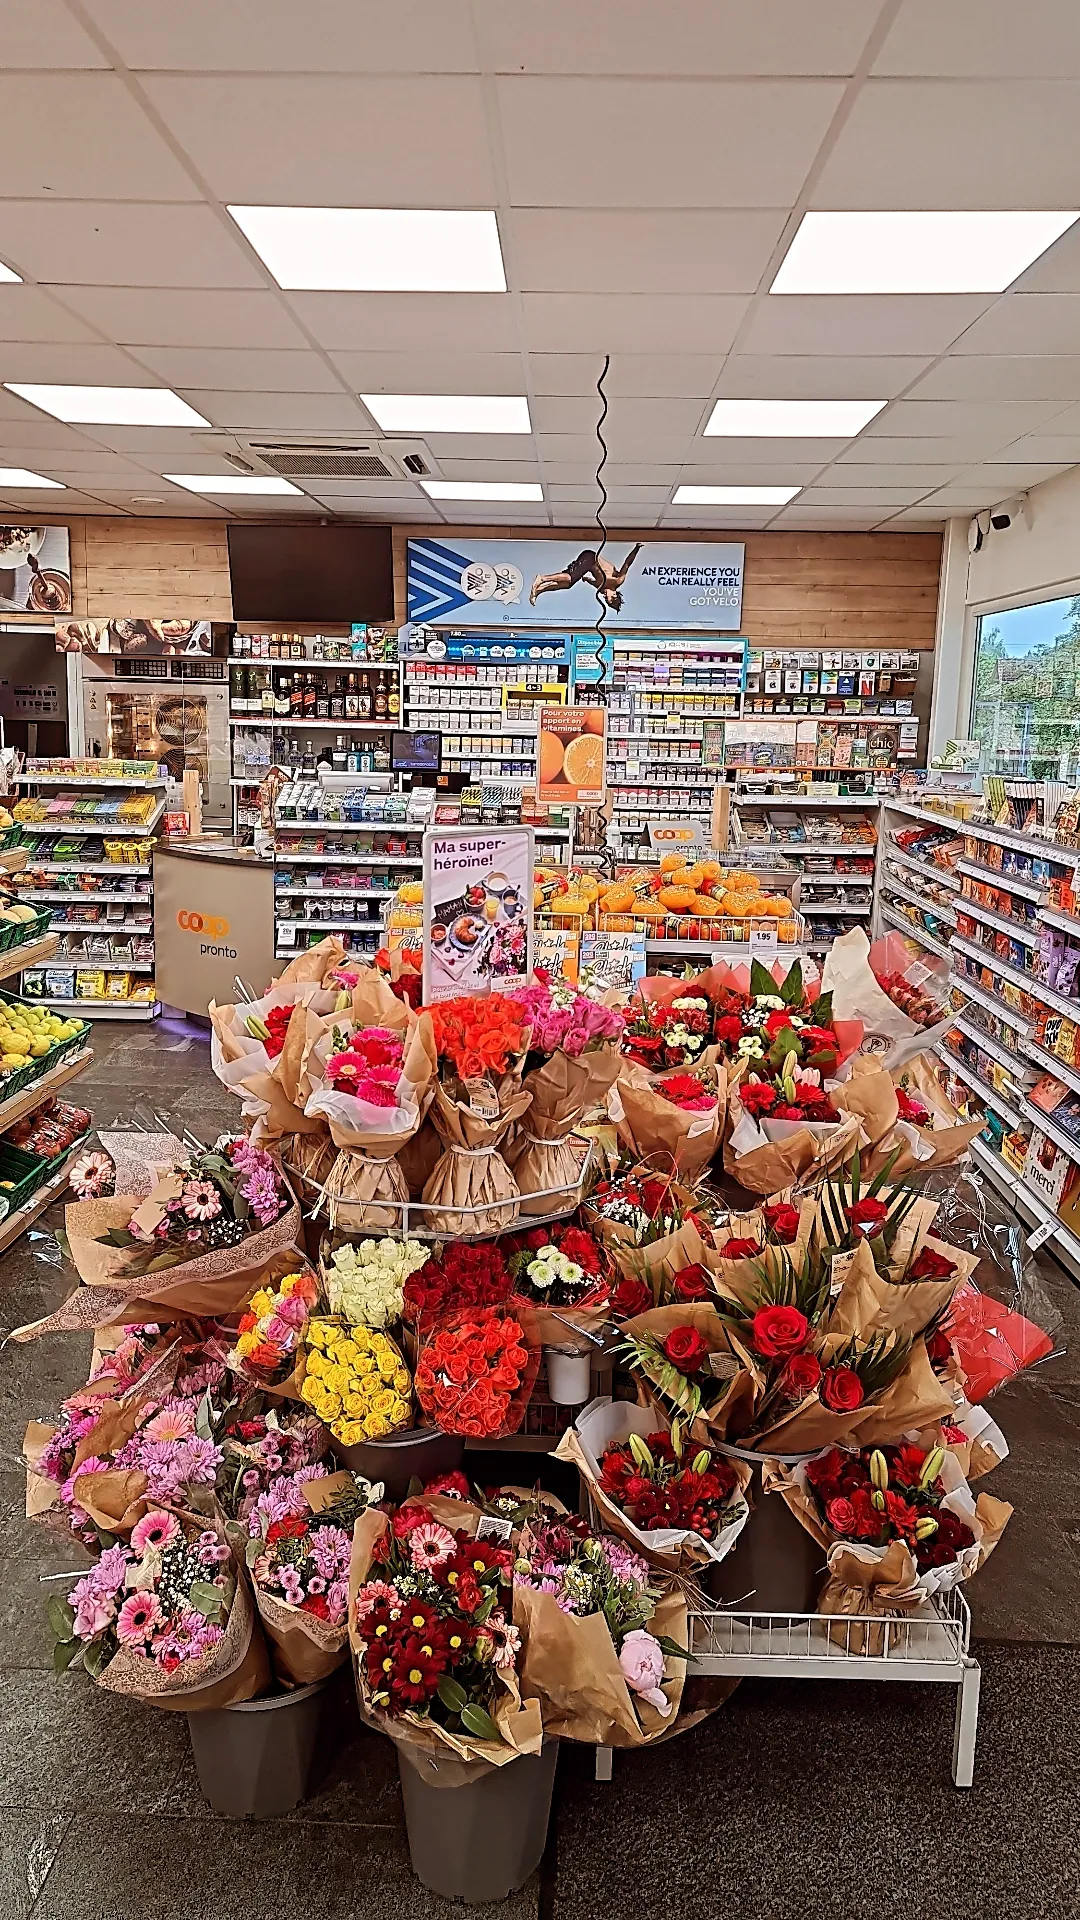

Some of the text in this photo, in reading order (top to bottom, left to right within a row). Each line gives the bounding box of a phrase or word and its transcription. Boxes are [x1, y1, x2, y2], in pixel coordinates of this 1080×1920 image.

[642, 567, 740, 576] AN EXPERIENCE YOU
[658, 577, 739, 587] CAN REALLY FEEL
[703, 588, 739, 596] YOU'VE
[689, 597, 739, 606] GOT VELO
[870, 737, 894, 748] chic
[653, 830, 695, 842] coop
[434, 840, 506, 853] Ma super-
[434, 854, 493, 870] héroïne!
[178, 910, 230, 941] coop
[757, 932, 771, 940] 1.95
[200, 944, 238, 959] pronto
[1030, 1165, 1056, 1196] merci
